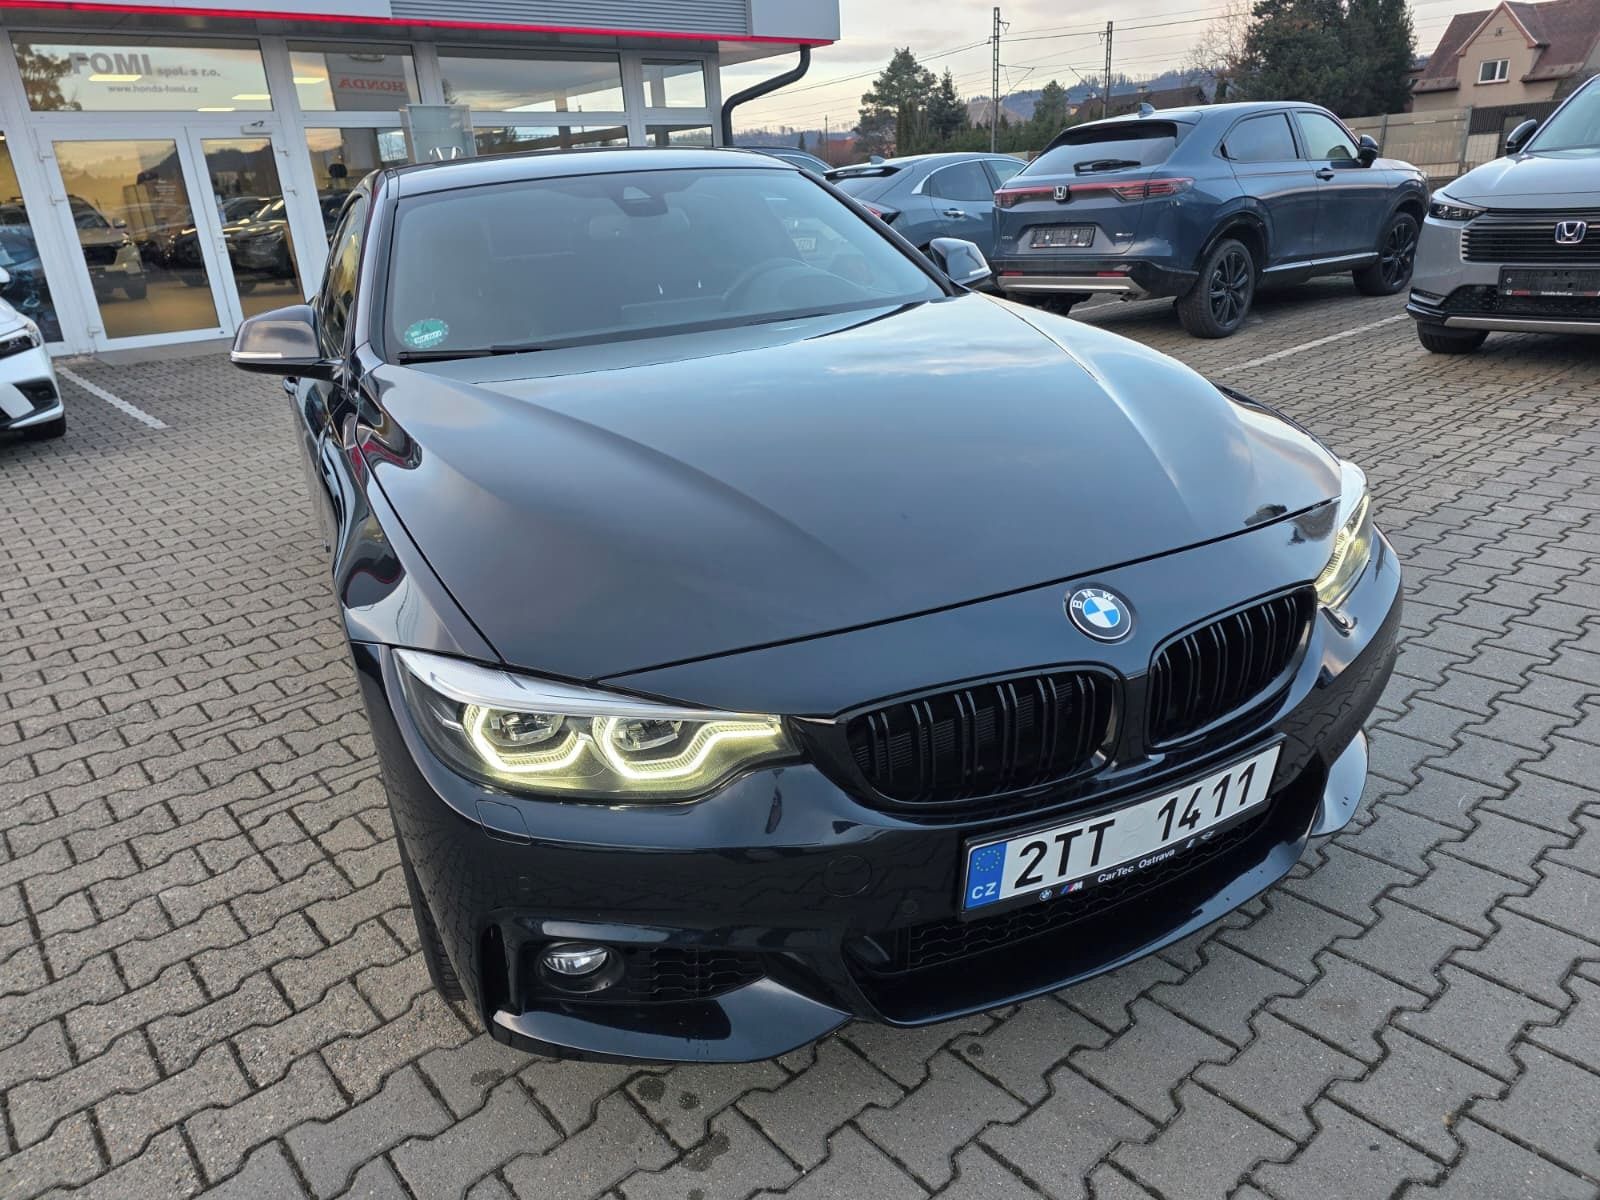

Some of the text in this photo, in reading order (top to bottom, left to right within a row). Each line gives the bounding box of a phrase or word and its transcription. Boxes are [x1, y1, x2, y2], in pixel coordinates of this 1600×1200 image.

[70, 52, 152, 75] FOMI
[1072, 590, 1114, 609] BMW
[1014, 762, 1257, 889] 2TT 1411
[1098, 865, 1134, 883] CarTec
[1138, 849, 1175, 868] Ostrava
[971, 881, 996, 899] CZ
